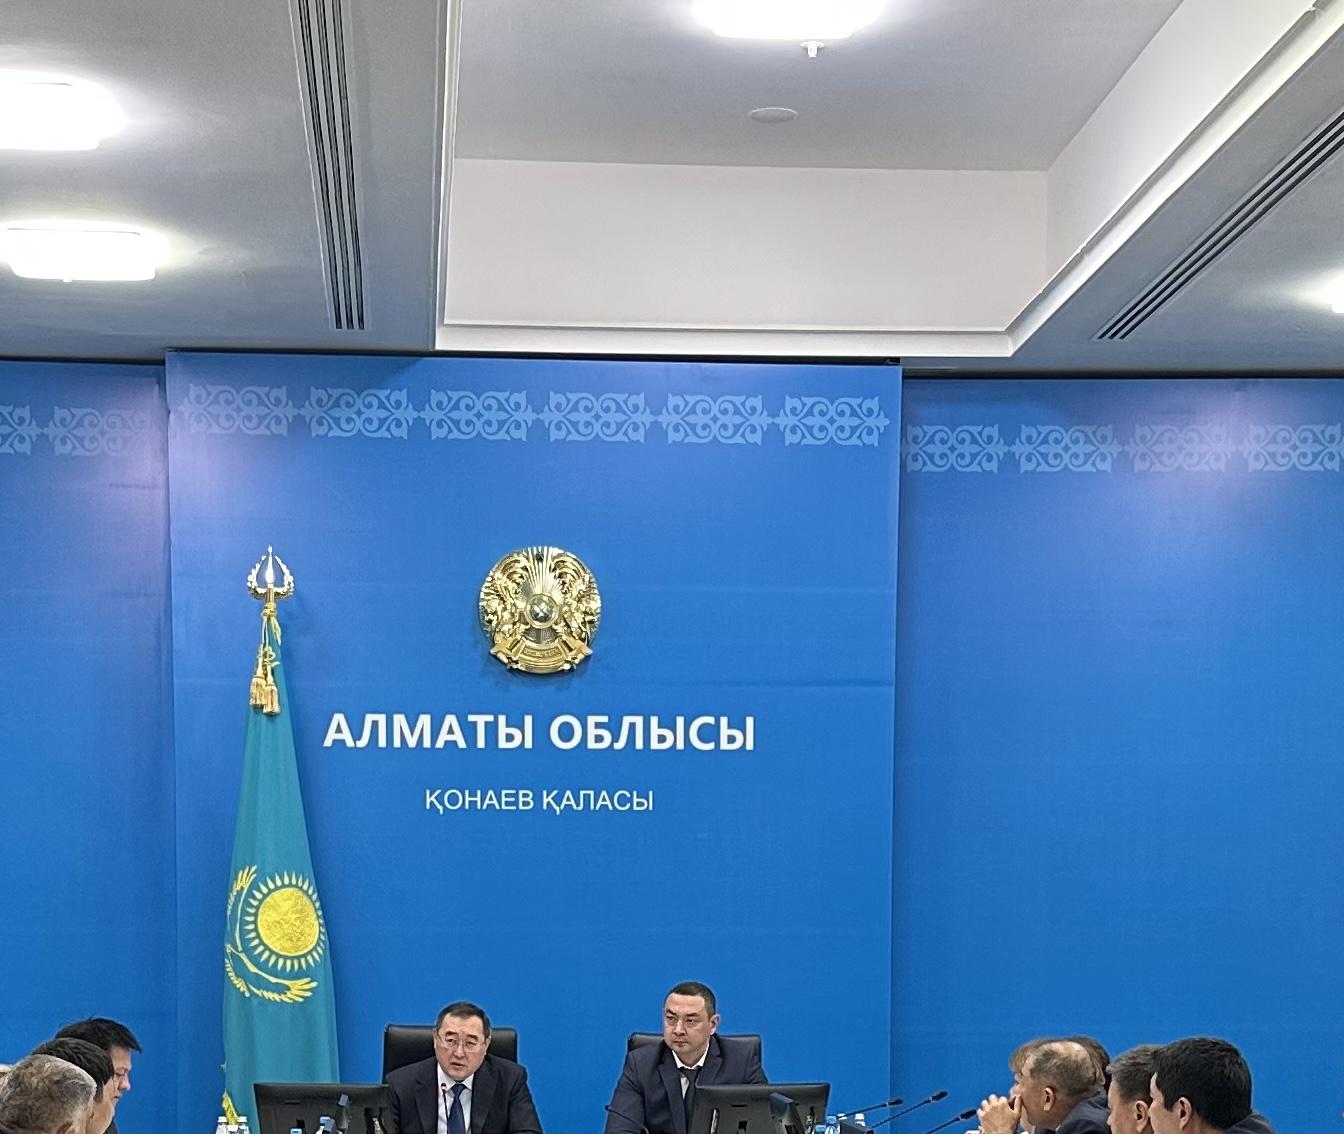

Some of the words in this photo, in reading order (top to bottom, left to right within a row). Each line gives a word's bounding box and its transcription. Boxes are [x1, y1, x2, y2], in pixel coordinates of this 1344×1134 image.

[323, 712, 533, 749] АЛМАТЫ
[550, 714, 754, 751] ОБЛЫСЫ
[425, 788, 534, 813] ҚОНАЕВ
[542, 789, 654, 814] ҚАЛАСЫ
